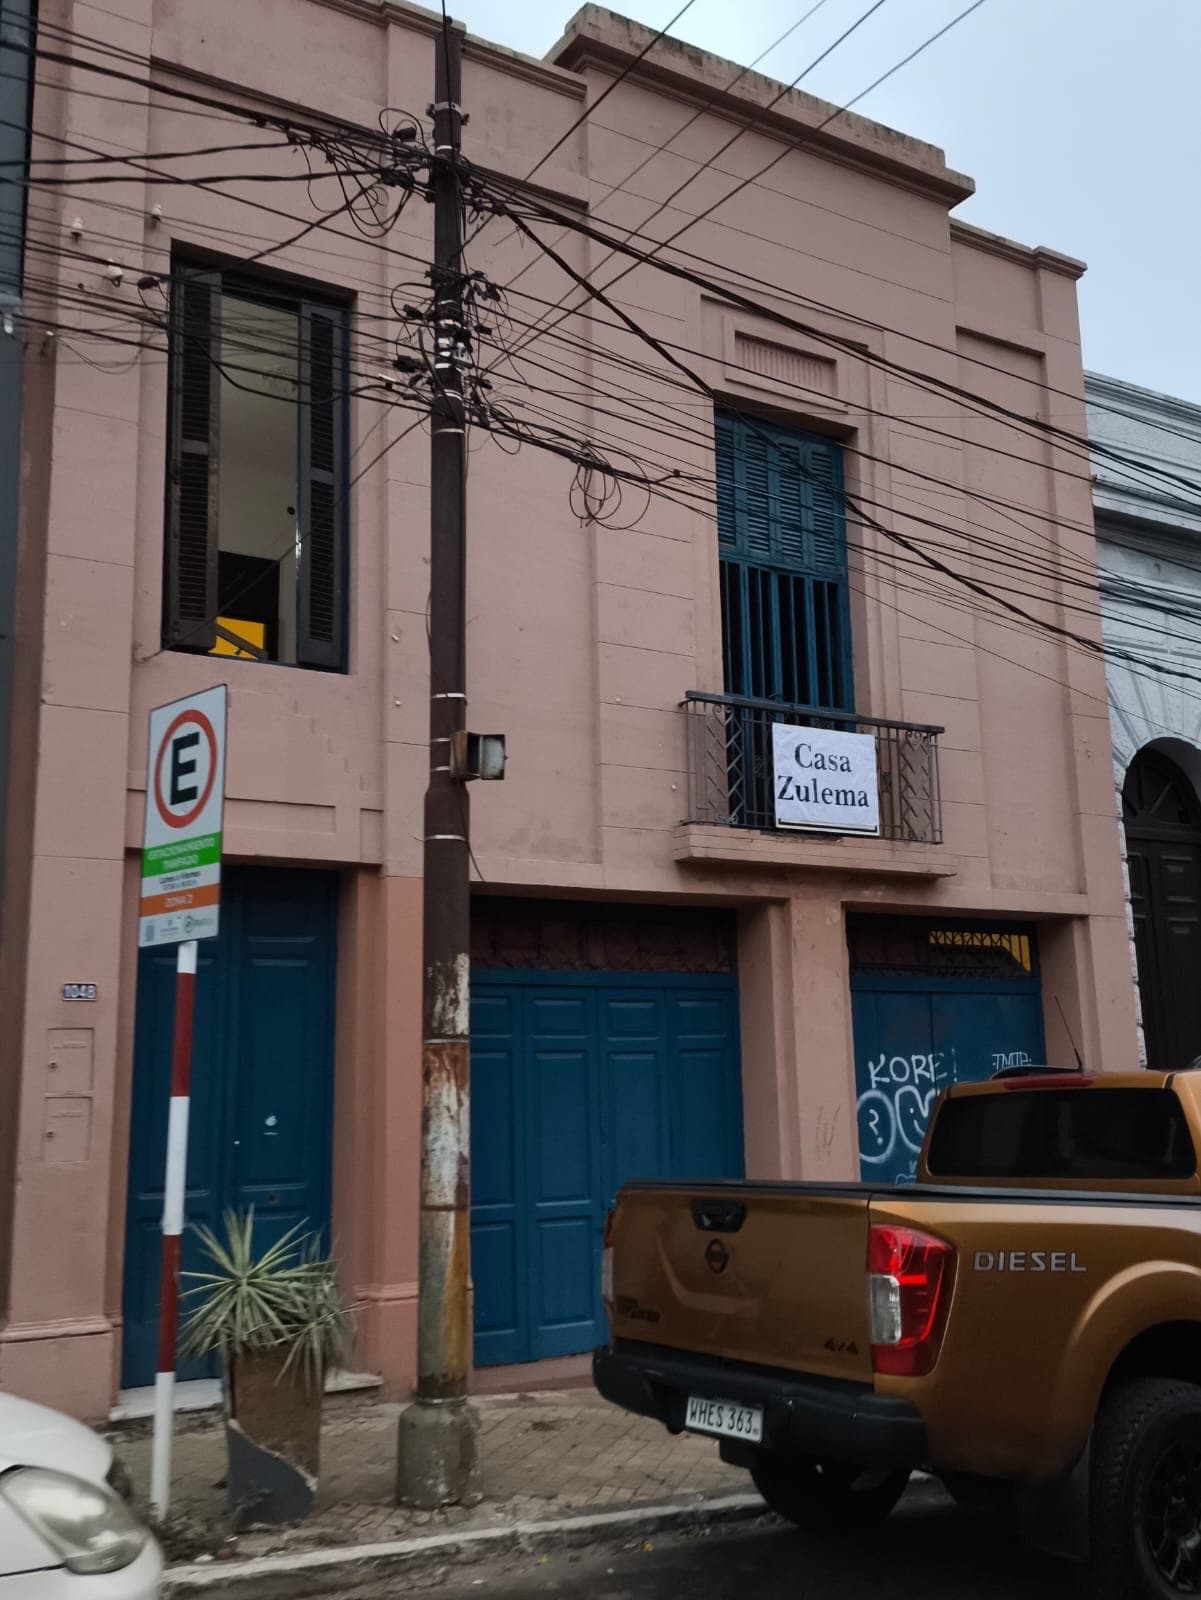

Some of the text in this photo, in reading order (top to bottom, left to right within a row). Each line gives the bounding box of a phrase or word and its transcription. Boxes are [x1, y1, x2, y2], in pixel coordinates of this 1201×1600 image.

[170, 731, 200, 805] E
[794, 743, 852, 772] Casa
[777, 775, 870, 807] Zulema
[974, 1251, 1087, 1272] DIESEL
[727, 1407, 753, 1434] 363
